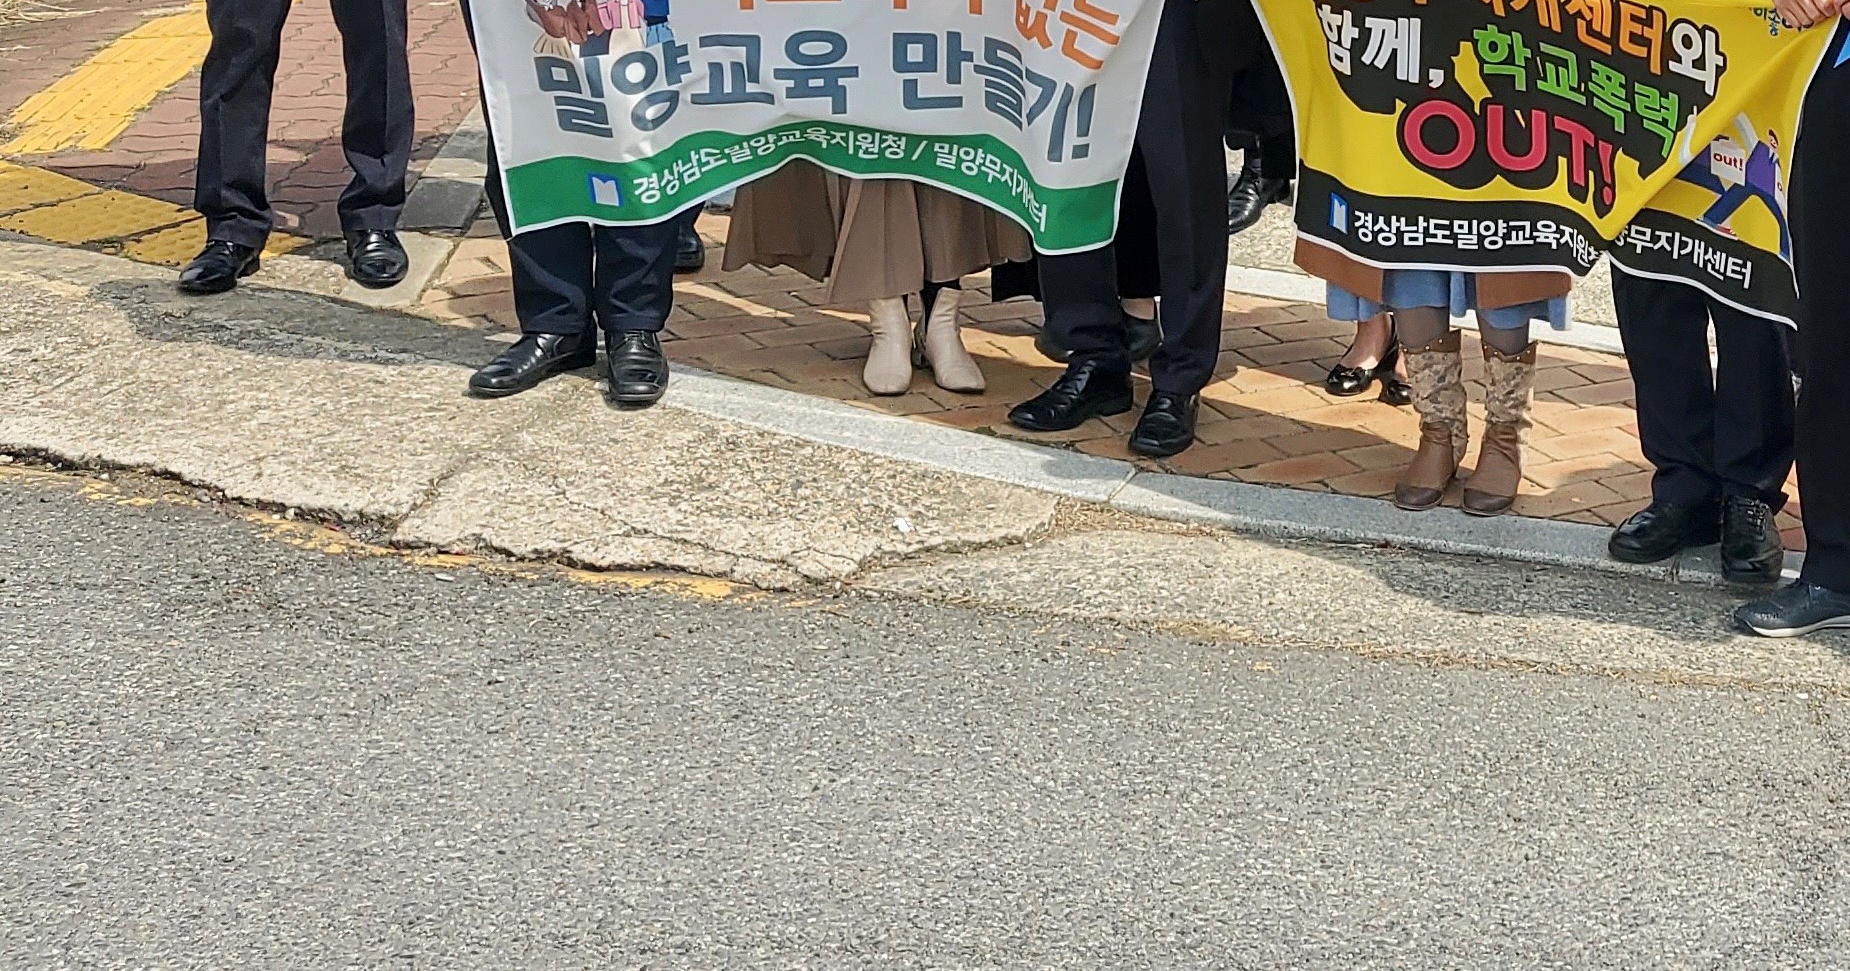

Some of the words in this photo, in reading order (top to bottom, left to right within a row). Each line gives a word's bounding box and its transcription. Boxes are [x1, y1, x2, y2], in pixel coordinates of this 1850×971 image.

[532, 29, 860, 138] 밀양교육
[891, 30, 1098, 165] 만들기!
[1316, 3, 1445, 88] 함께,
[1472, 24, 1680, 158] 학교폭력
[932, 141, 1047, 234] 밀양무지개센터
[1402, 98, 1616, 206] OUT!
[1713, 151, 1744, 172] out!
